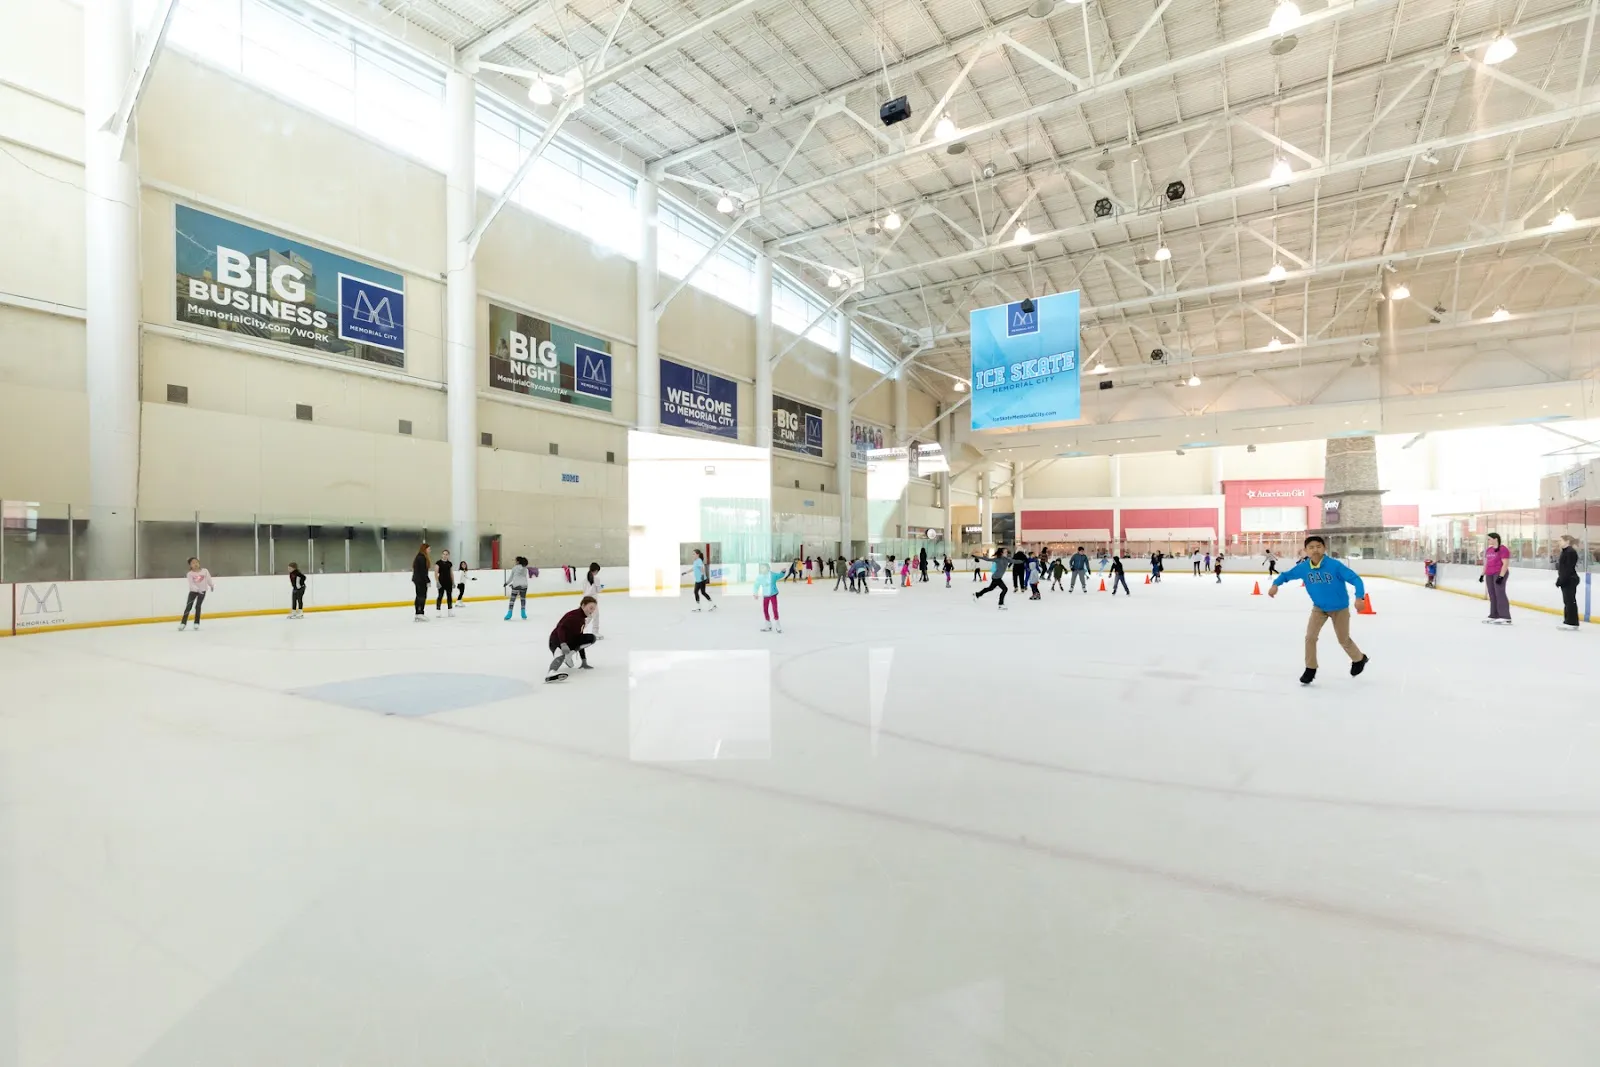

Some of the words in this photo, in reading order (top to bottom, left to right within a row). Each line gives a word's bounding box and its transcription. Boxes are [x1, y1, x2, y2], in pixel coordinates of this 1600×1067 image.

[217, 245, 306, 302] BIG
[189, 278, 328, 329] BUSINESS
[187, 303, 329, 343] MemorialCity.com/WORK
[350, 325, 382, 338] MEMORIAL
[384, 333, 398, 341] CITY
[510, 330, 557, 368] BIG
[510, 360, 557, 383] NIGHT
[976, 366, 1005, 390] ICE
[1010, 350, 1075, 382] SKATE
[992, 381, 1033, 393] MEMORIAL
[1036, 376, 1055, 384] CITY
[667, 386, 732, 417] WELCOME
[664, 402, 675, 413] TO
[677, 406, 717, 423] MEMORIAL
[718, 417, 734, 426] CITY
[777, 408, 798, 431] BIG
[780, 429, 795, 440] FUN
[1256, 489, 1291, 498] American
[1291, 489, 1305, 497] Girl
[1307, 571, 1334, 584] GAP
